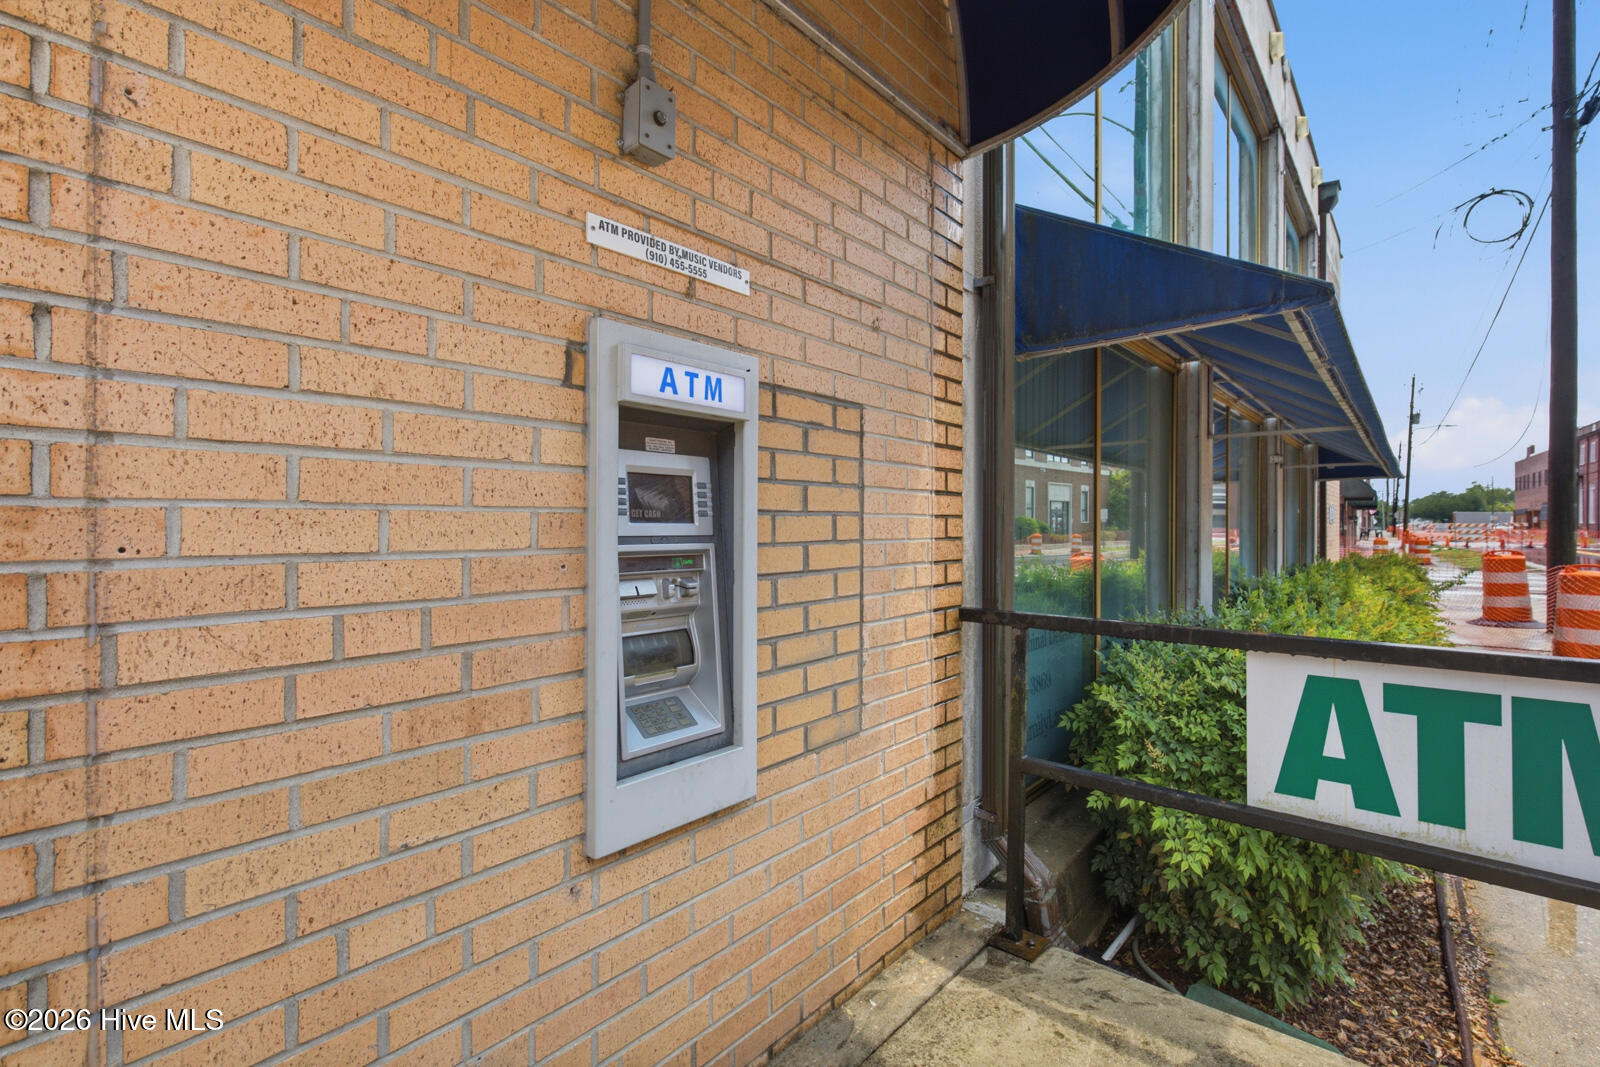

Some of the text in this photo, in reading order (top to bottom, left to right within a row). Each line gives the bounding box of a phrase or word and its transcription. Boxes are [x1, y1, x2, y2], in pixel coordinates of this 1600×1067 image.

[598, 219, 619, 236] ATM
[621, 227, 667, 252] PROVIDED
[681, 249, 707, 267] MUSIC
[708, 256, 742, 280] VENDORS
[645, 247, 708, 279] (910) 455-5555
[659, 366, 723, 403] ATM
